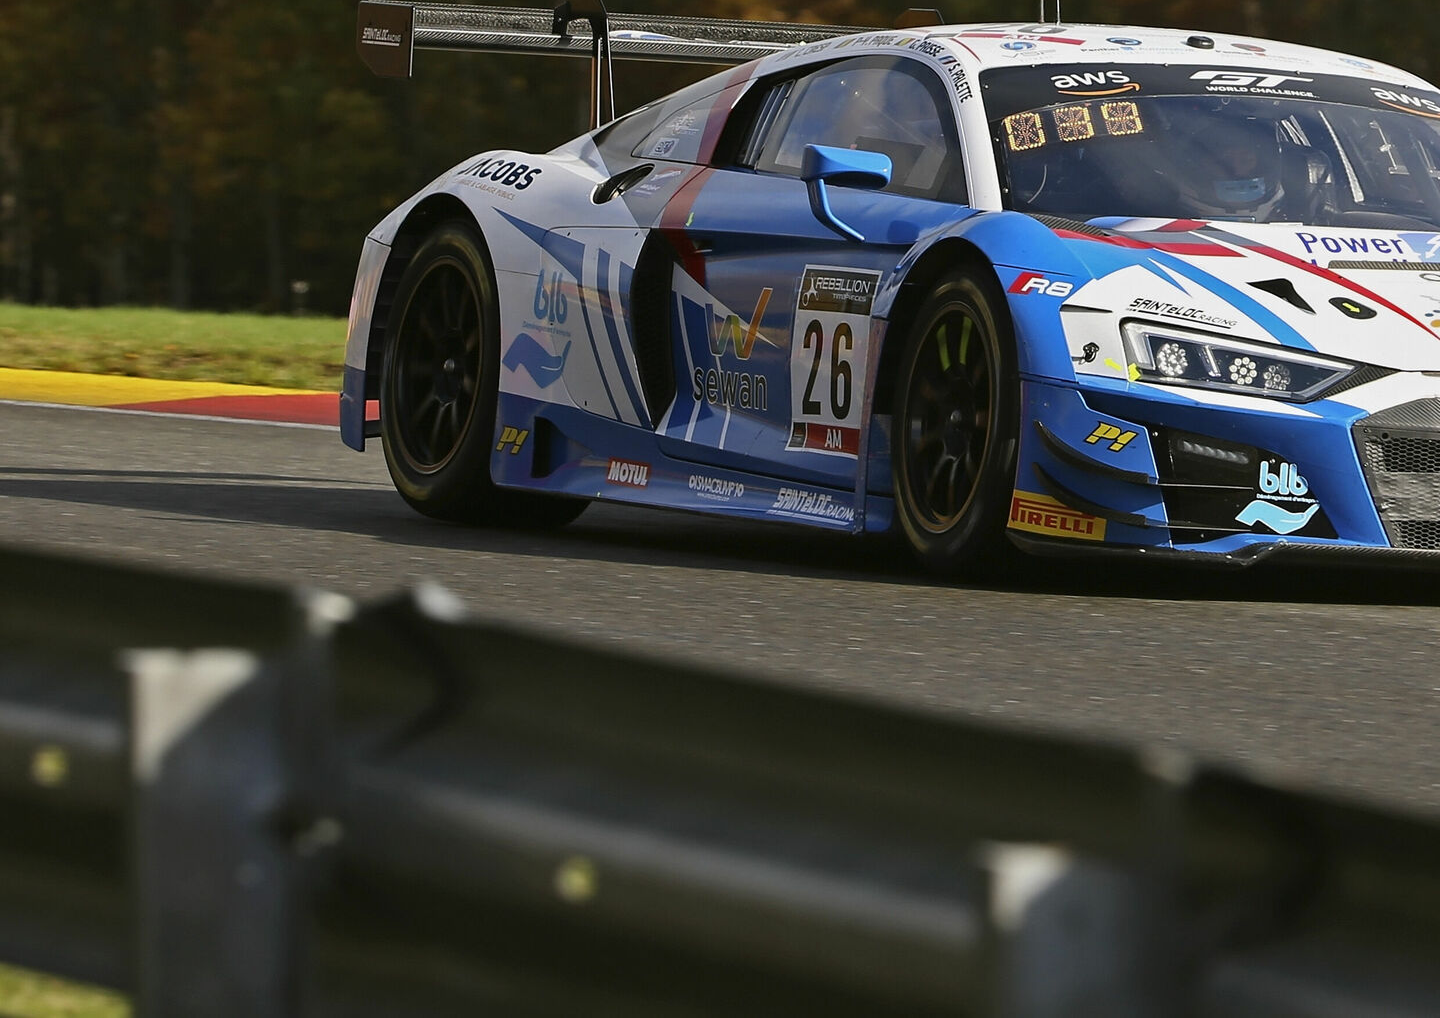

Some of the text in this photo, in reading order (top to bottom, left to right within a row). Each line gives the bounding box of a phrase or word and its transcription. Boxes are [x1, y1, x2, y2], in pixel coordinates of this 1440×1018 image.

[1002, 33, 1041, 41] AM
[1051, 70, 1130, 89] aws
[1189, 70, 1314, 87] GT
[1205, 85, 1315, 99] WORLD CHALLENGE
[455, 158, 543, 190] JACOBS
[1296, 232, 1404, 254] Power
[534, 268, 568, 324] blb
[815, 277, 871, 294] REBELLION
[1021, 278, 1075, 298] R8
[1198, 314, 1238, 327] RACING
[802, 319, 853, 420] 26
[692, 366, 768, 411] sewan
[824, 428, 843, 450] AM
[608, 460, 648, 486] MOTUL
[1259, 460, 1309, 496] blb
[1011, 497, 1097, 535] PIRELLI
